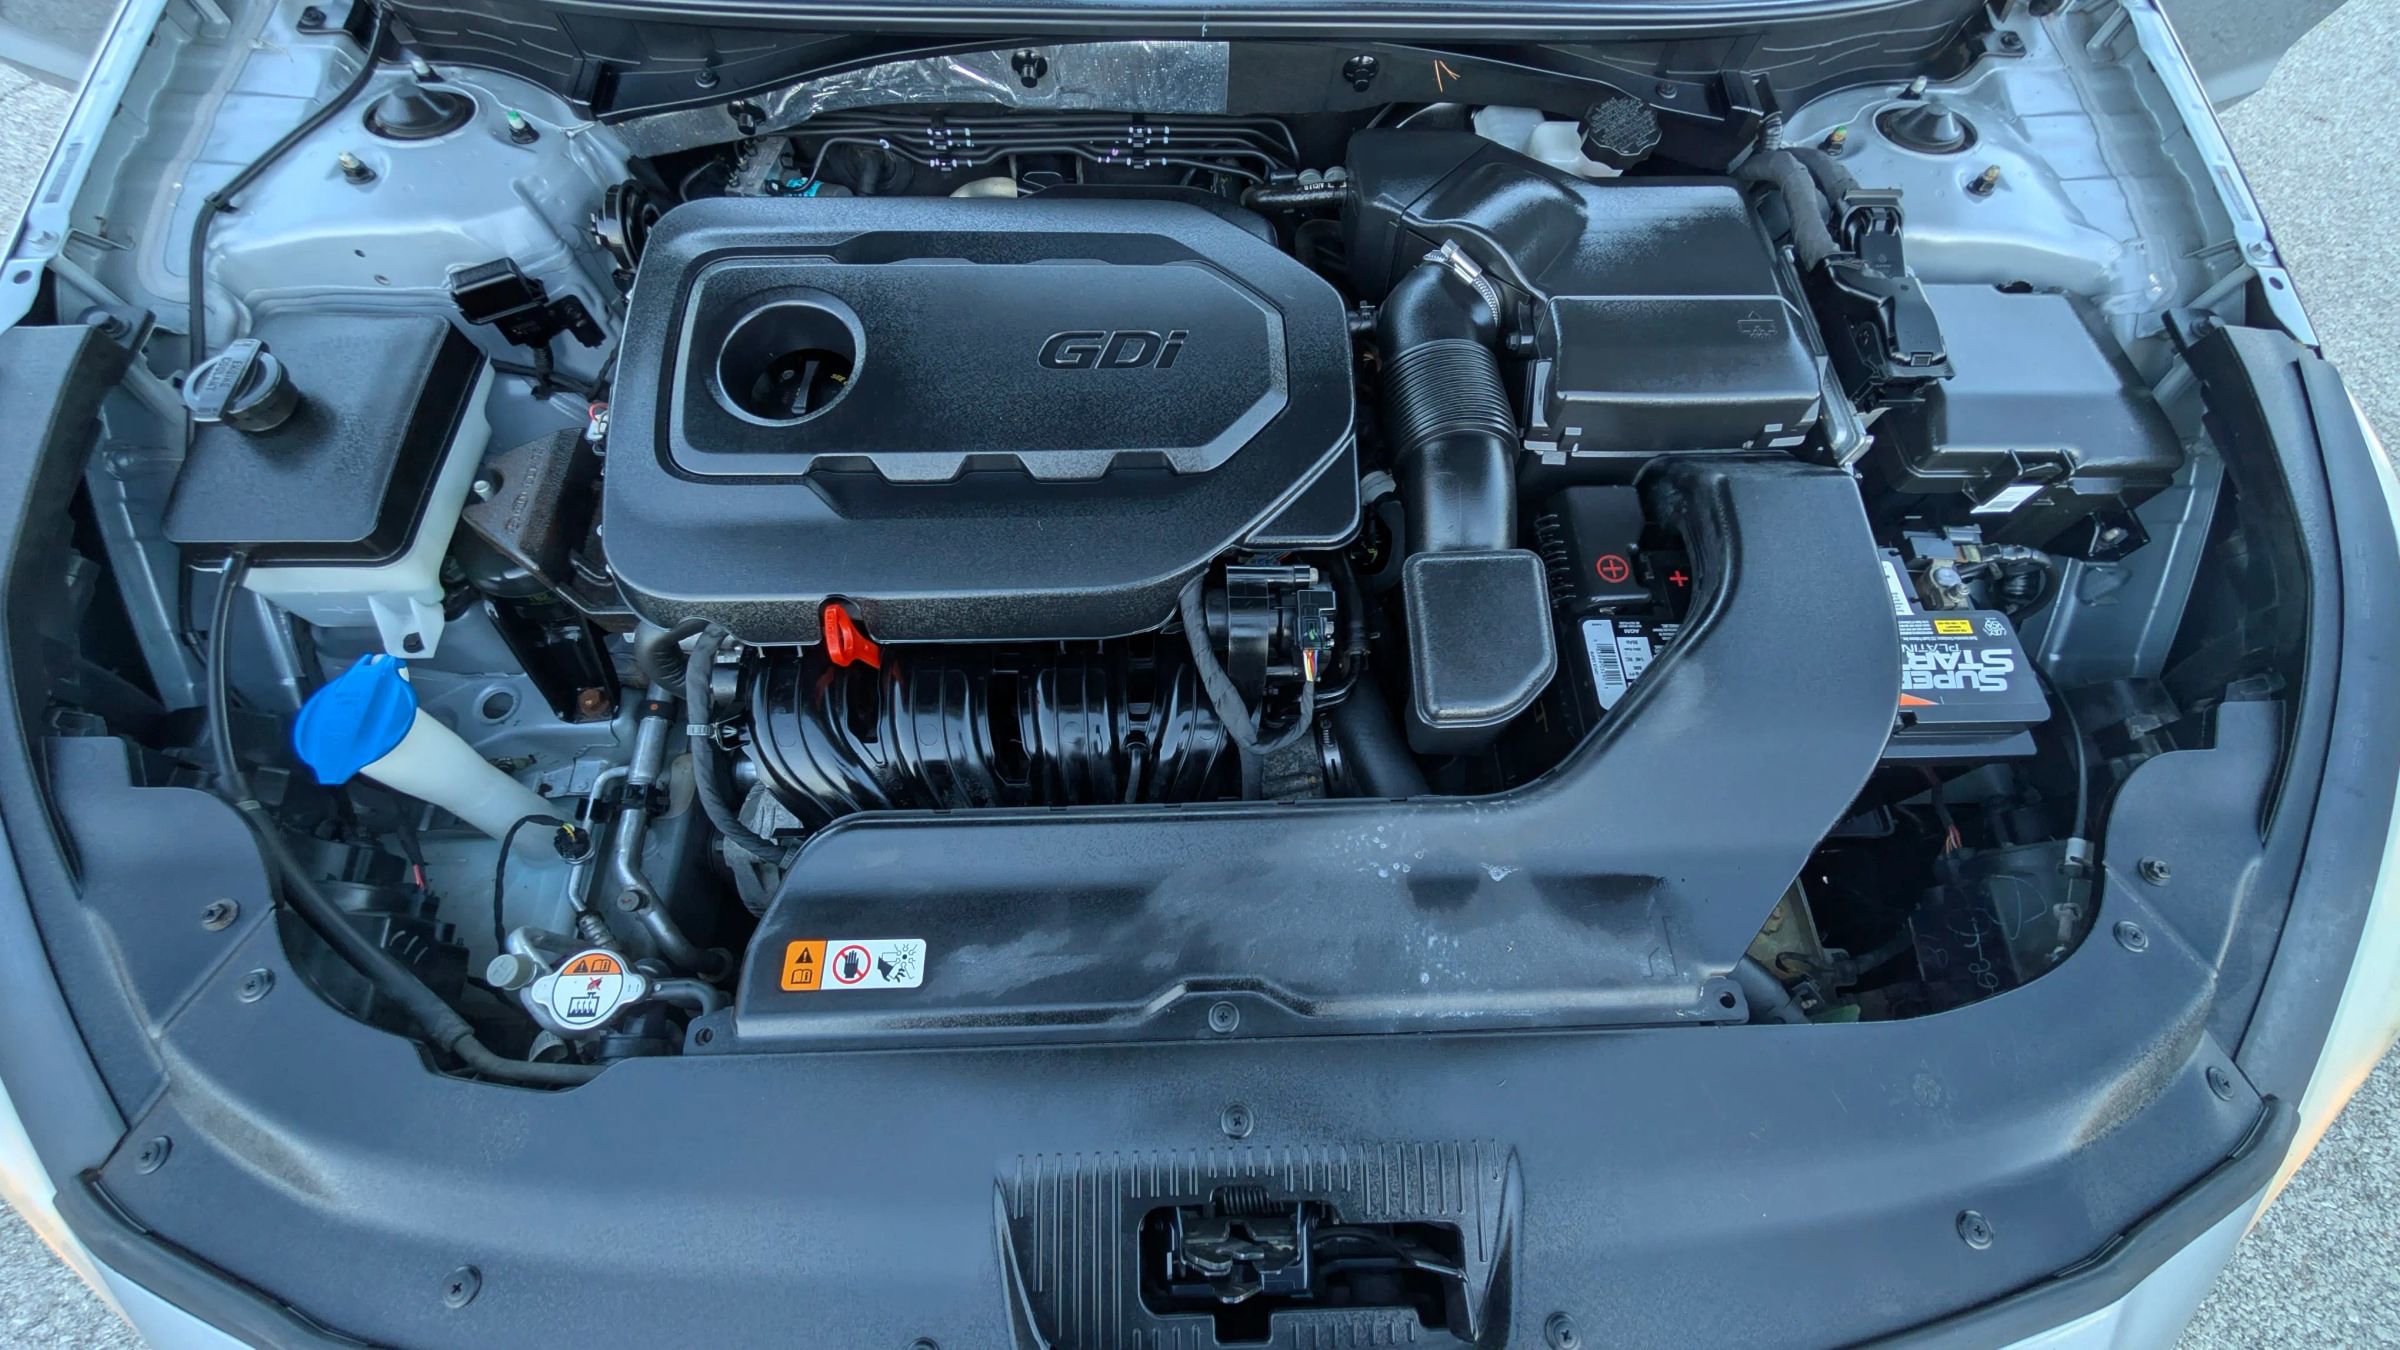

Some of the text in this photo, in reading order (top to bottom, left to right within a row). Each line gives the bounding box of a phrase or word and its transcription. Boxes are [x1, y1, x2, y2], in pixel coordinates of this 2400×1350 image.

[1037, 329, 1190, 369] GDi
[206, 357, 232, 390] COOLANT
[219, 360, 243, 388] ENGINE
